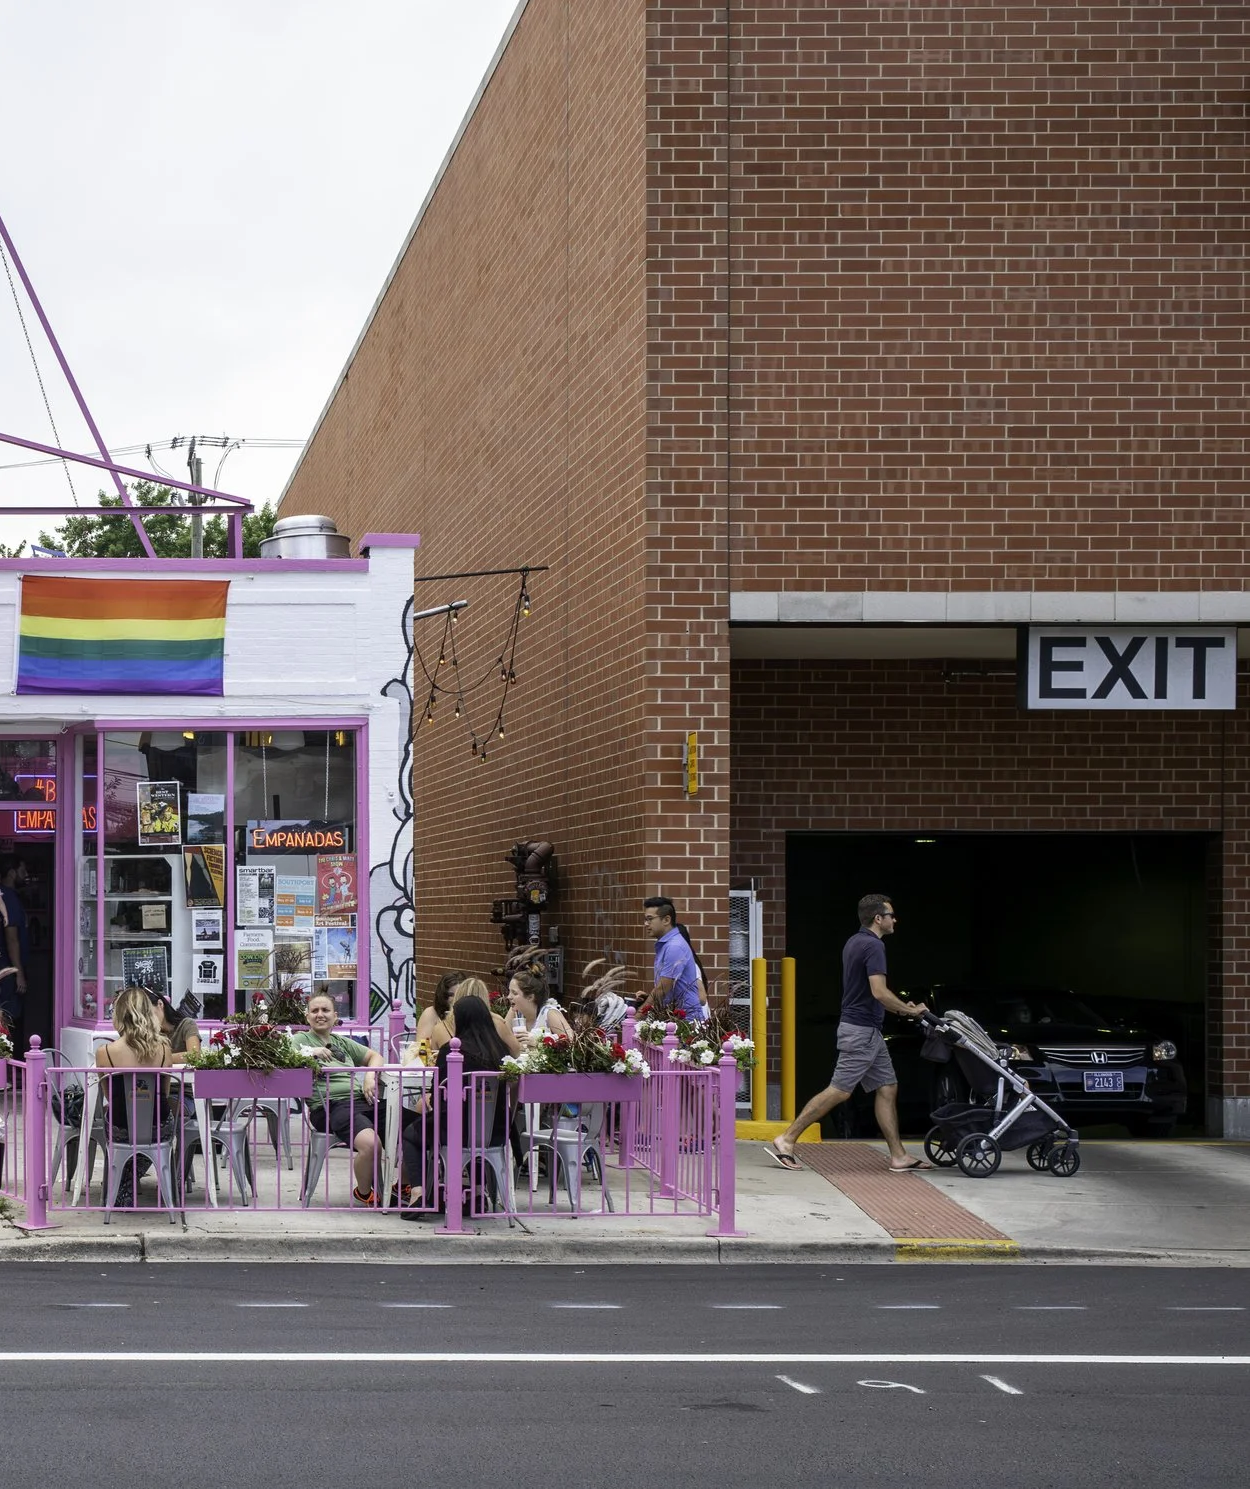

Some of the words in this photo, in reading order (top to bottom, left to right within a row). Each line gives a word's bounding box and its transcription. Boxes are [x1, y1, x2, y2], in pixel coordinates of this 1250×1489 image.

[1038, 636, 1226, 699] EXIT
[18, 807, 96, 829] EMPAAS
[253, 828, 344, 848] EMPANADAS
[1094, 1077, 1114, 1088] 2143
